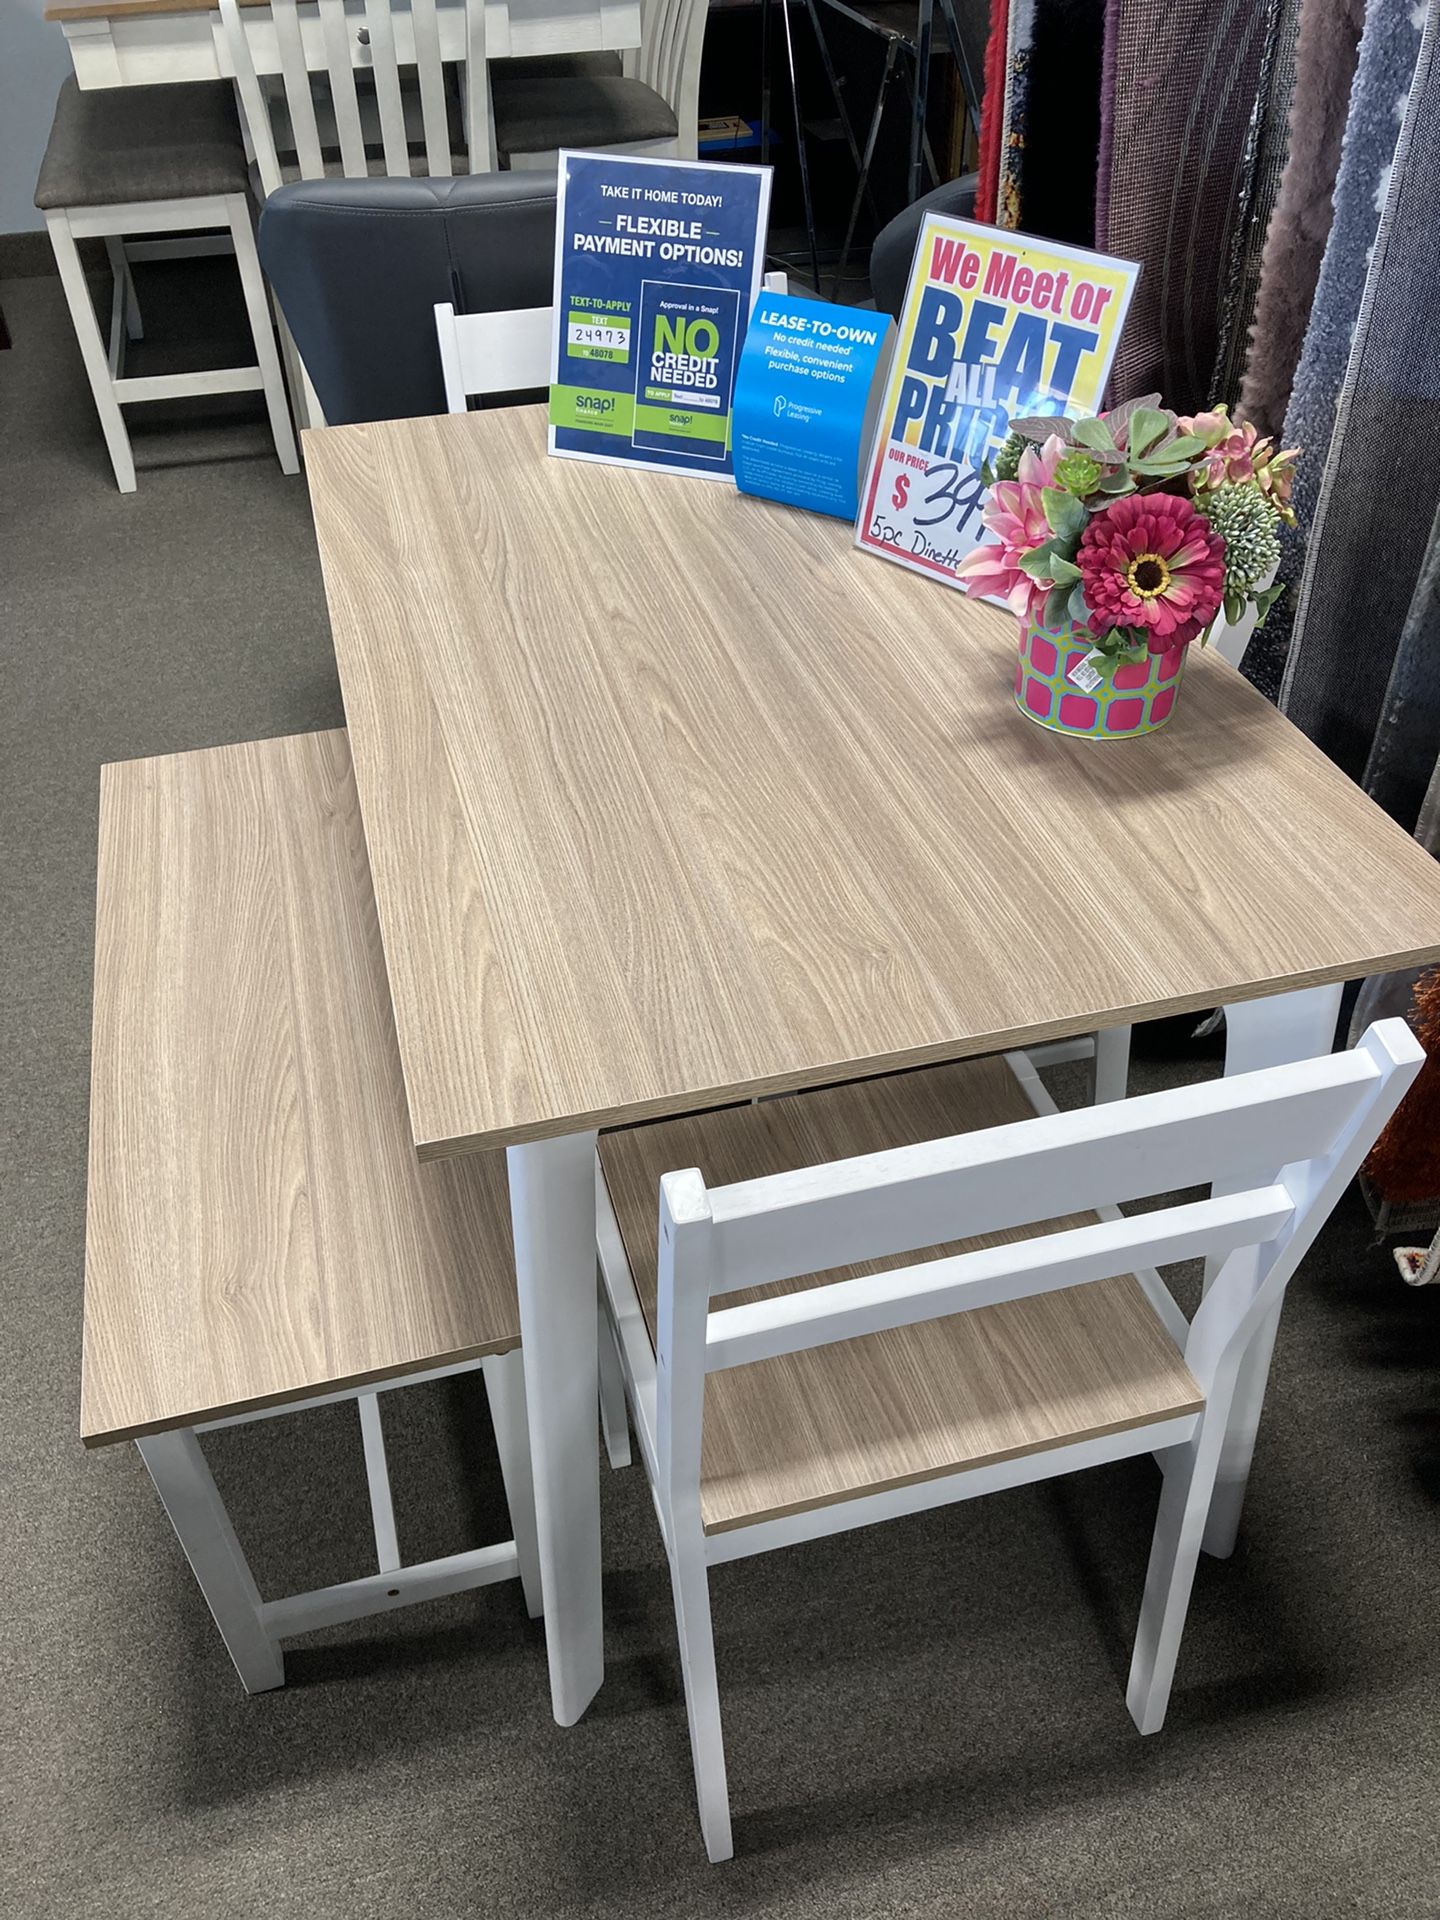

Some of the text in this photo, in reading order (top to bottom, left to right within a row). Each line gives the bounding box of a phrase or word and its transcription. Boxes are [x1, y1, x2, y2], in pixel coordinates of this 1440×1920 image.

[601, 185, 722, 207] TAKE IT HOME TODAY!
[616, 214, 702, 239] FLEXIBLE
[573, 233, 743, 267] PAYMENT OPTIONS!
[929, 236, 1112, 325] We Meet or
[570, 295, 631, 312] TEXT-TO-APPLY
[700, 305, 719, 315] Snap!
[591, 315, 608, 325] TEXT
[760, 310, 877, 346] LEASE-TO-OWN
[576, 328, 626, 345] 24973
[653, 314, 720, 360] NO
[773, 331, 786, 343] No
[787, 334, 815, 349] credit
[589, 348, 614, 359] 48078
[764, 346, 853, 372] Flexible, convenient
[907, 285, 1099, 416] BEAT
[652, 351, 719, 374] CREDIT
[768, 360, 846, 384] purchase options
[650, 366, 718, 389] NEEDED
[944, 361, 999, 409] ALL
[576, 395, 615, 414] snap!
[788, 401, 822, 416] Progressive
[669, 414, 693, 425] snap!
[889, 448, 929, 472] OUR PRICE
[891, 473, 911, 511] $
